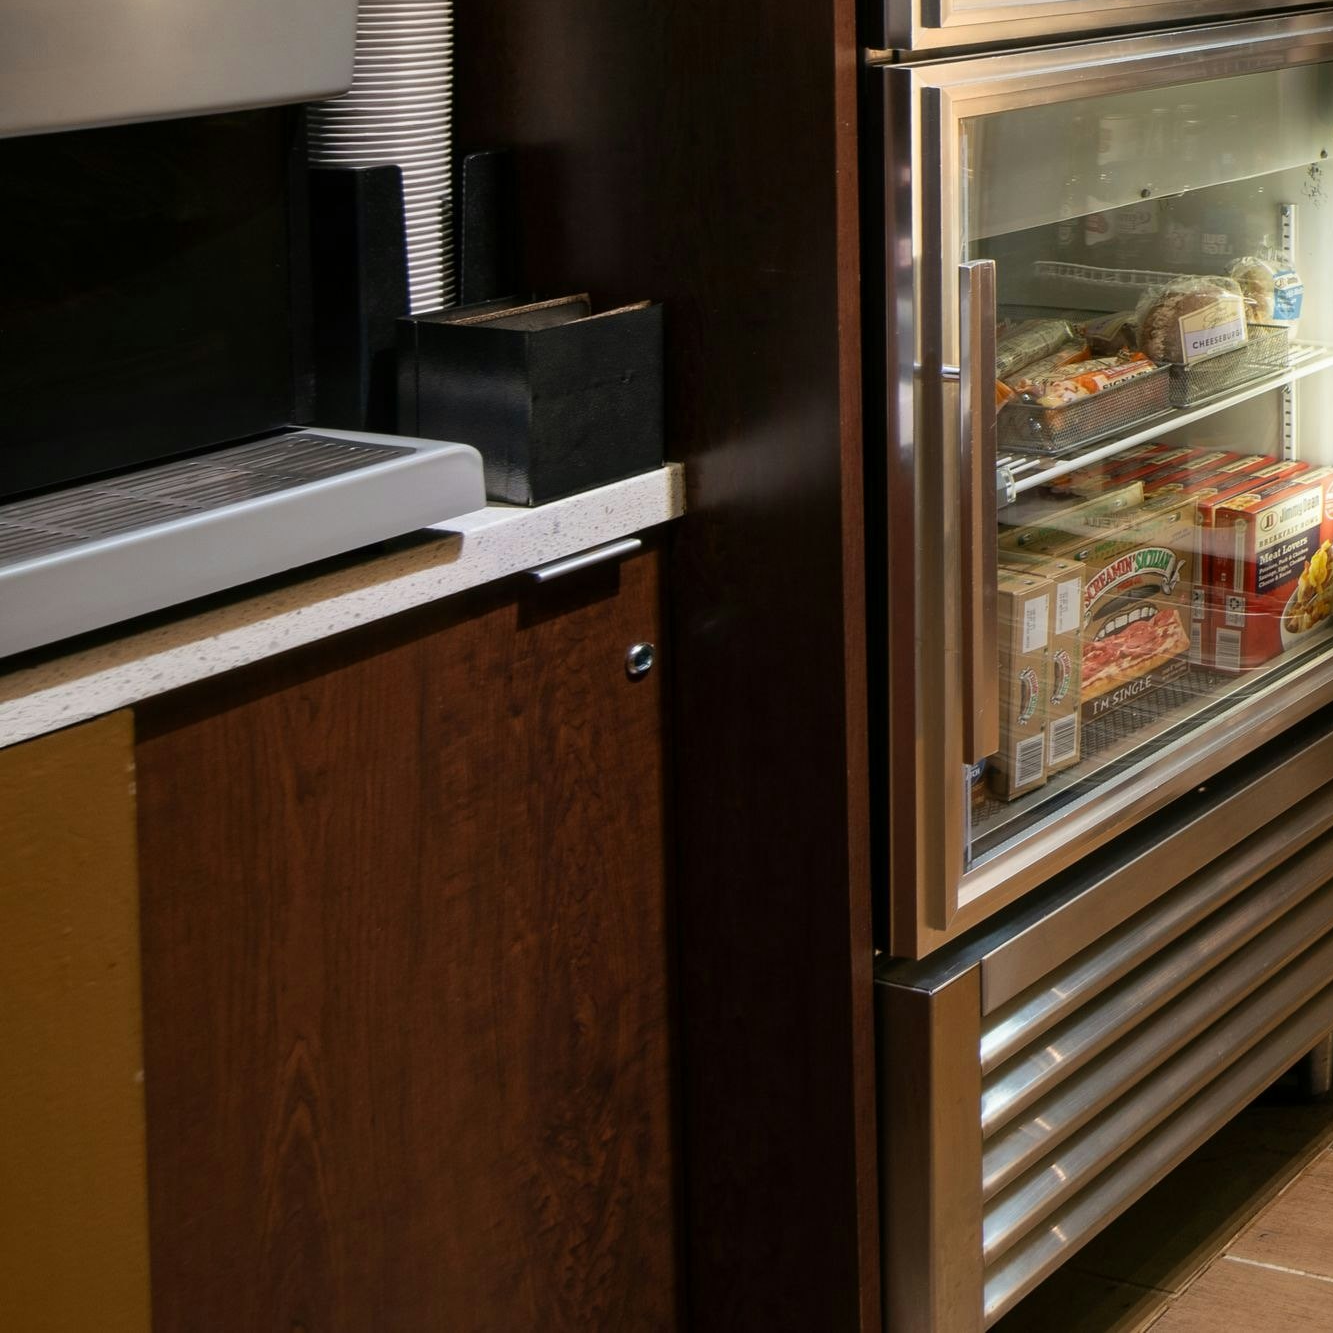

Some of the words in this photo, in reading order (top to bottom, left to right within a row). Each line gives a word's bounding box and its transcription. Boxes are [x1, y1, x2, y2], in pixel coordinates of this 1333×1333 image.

[1192, 329, 1242, 350] CHEESEBURG
[1259, 525, 1299, 548] BREAKFAST
[1259, 548, 1281, 566] Meat
[1282, 536, 1309, 555] Lovers
[1092, 697, 1110, 715] I'M
[1111, 673, 1153, 707] SINGLE
